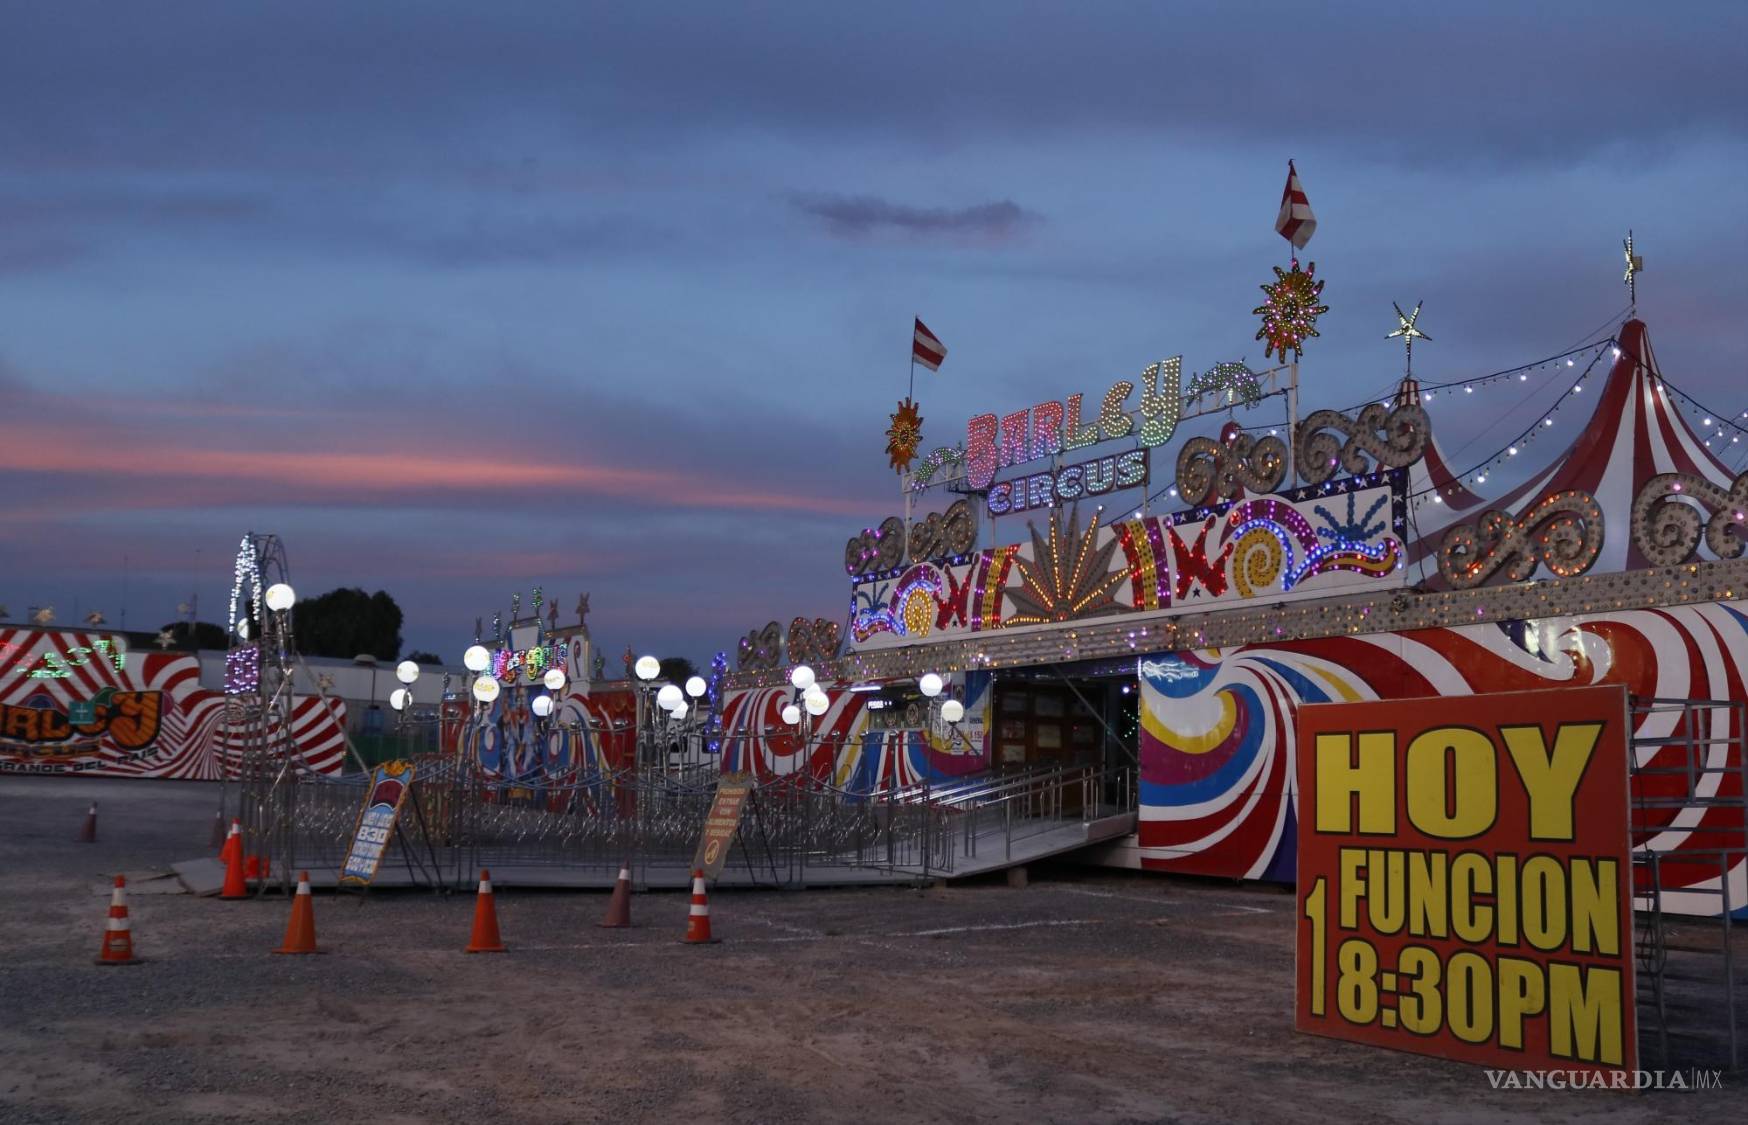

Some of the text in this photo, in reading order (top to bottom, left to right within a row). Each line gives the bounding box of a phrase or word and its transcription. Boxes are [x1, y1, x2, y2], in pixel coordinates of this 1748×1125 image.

[987, 450, 1147, 515] CIRCUS
[0, 760, 66, 773] RANDE
[73, 760, 107, 772] DEL
[1315, 721, 1607, 842] HOY
[1304, 846, 1621, 1018] 1 FUNCION
[1337, 939, 1625, 1067] 8:30PM
